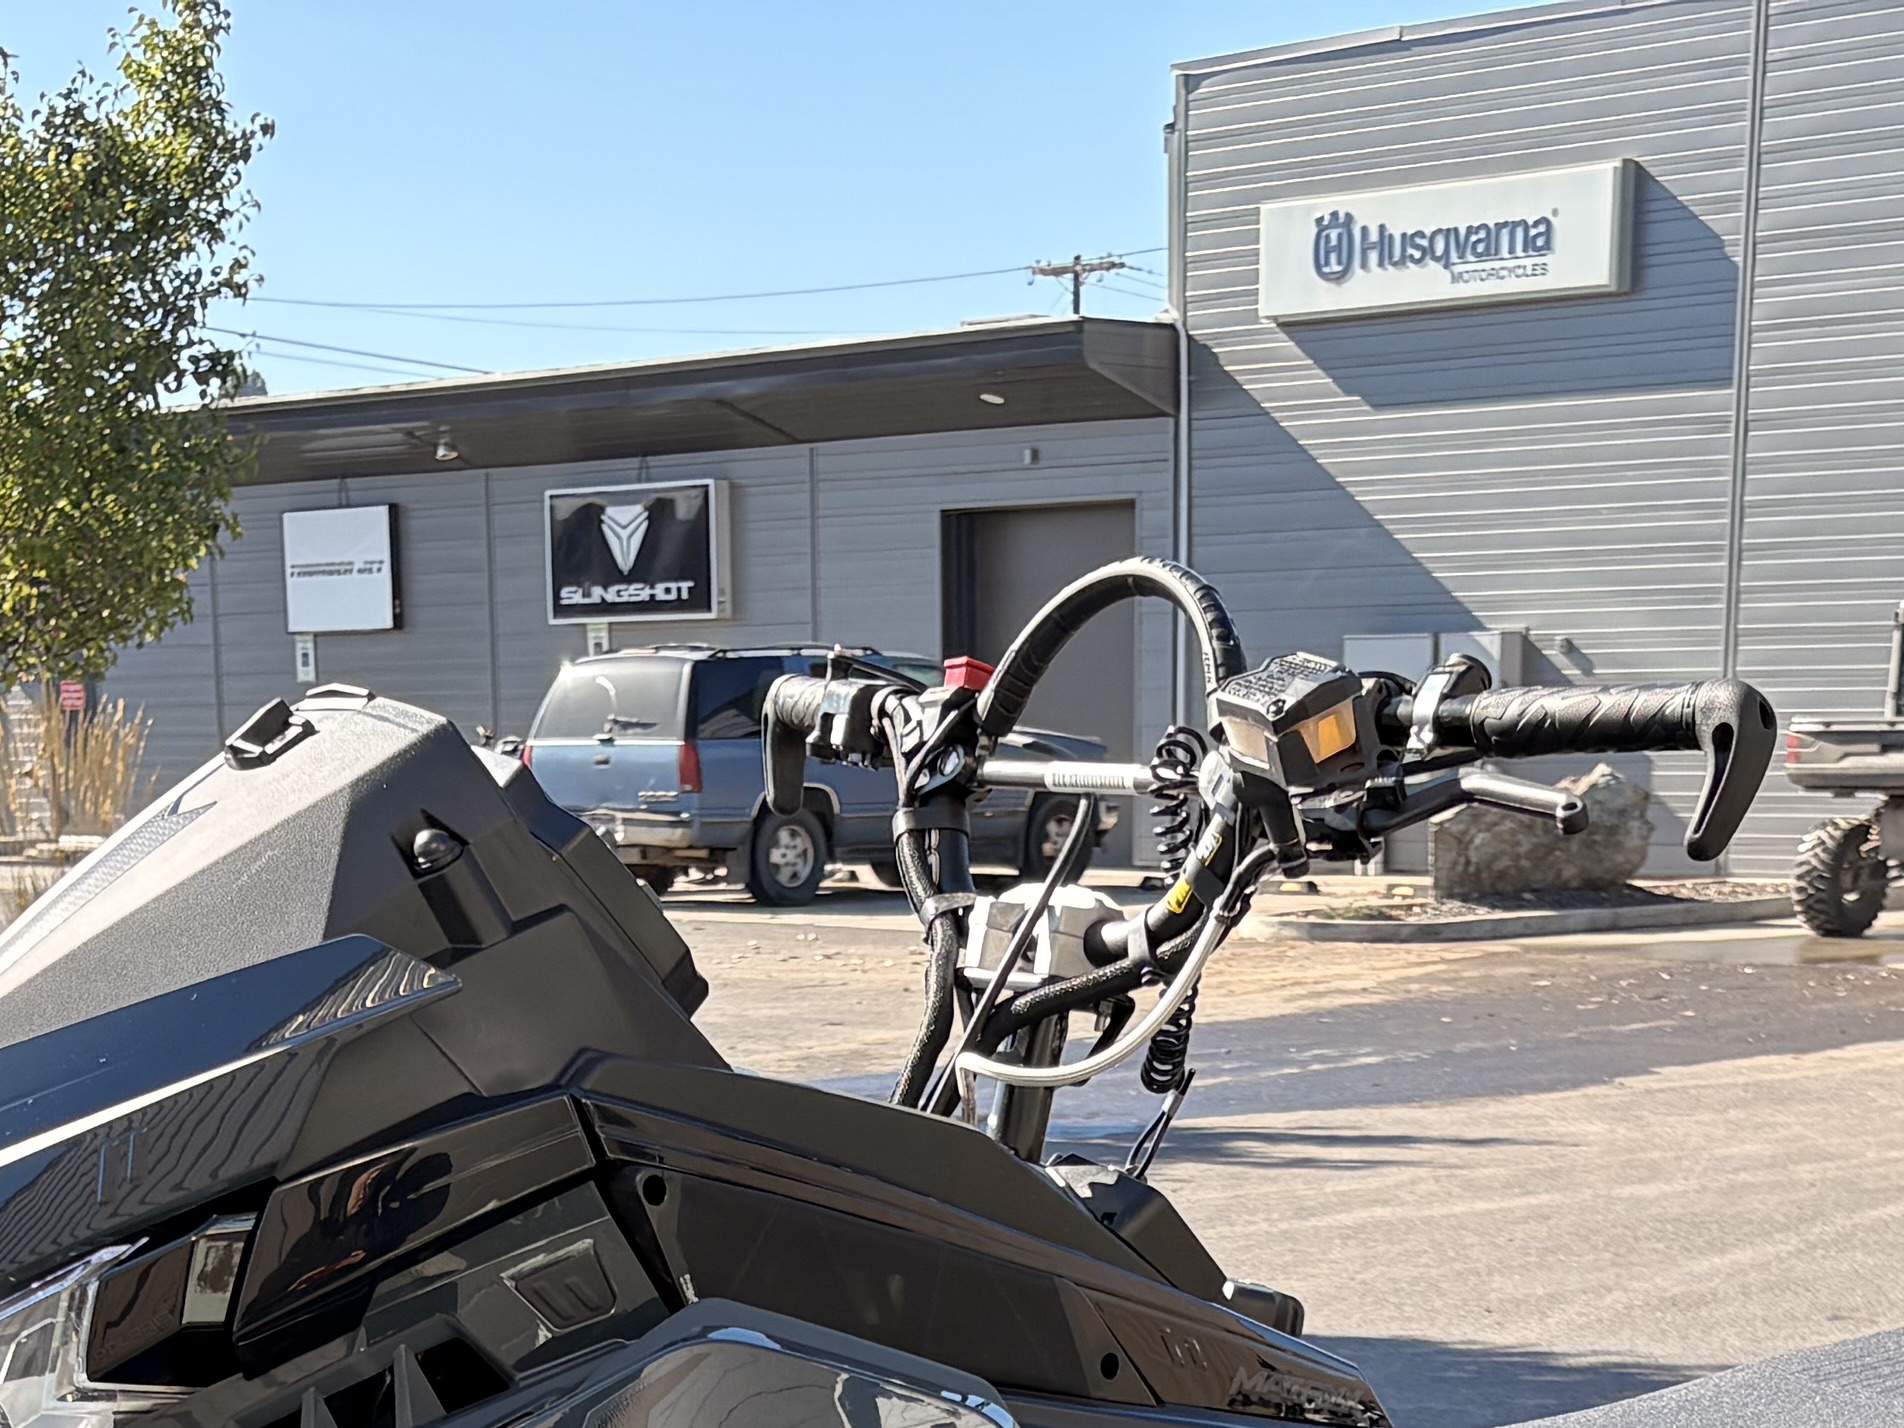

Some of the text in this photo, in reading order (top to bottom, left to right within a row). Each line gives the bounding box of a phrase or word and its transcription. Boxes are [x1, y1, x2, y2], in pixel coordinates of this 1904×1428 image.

[1360, 216, 1554, 272] Husqvarna
[1450, 262, 1549, 285] MOTORCYCLES
[559, 581, 695, 605] SLINGSHOT
